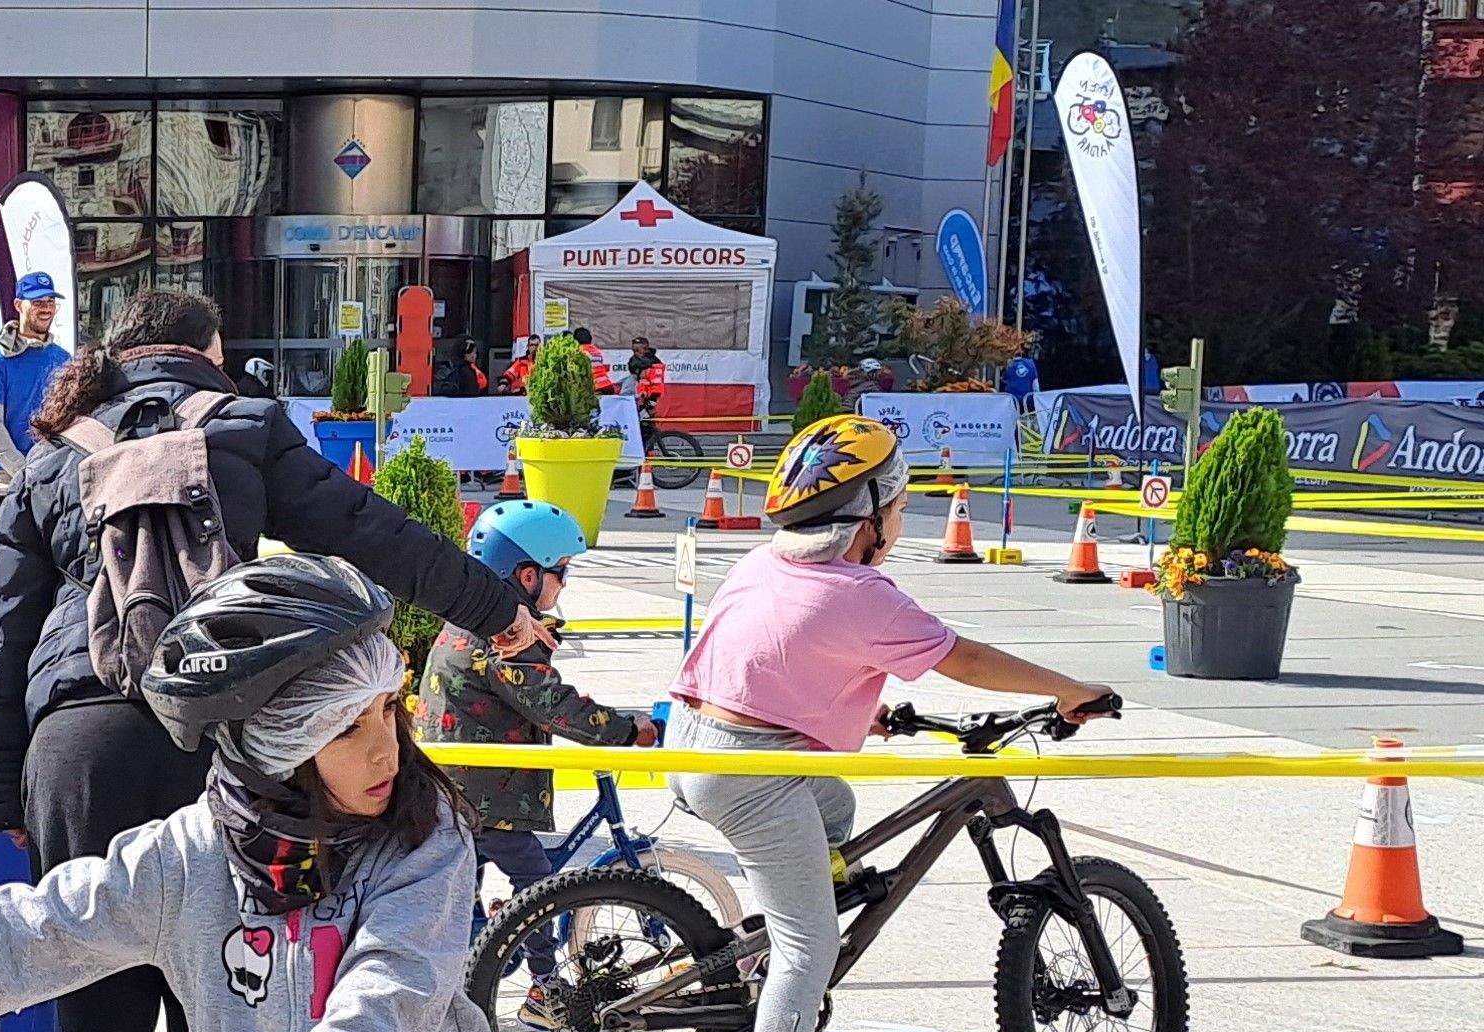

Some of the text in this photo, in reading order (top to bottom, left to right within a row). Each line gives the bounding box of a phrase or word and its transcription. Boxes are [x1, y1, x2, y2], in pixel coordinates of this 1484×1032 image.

[562, 247, 747, 267] PUNT DE SOCORS
[612, 364, 630, 373] CRE
[1081, 412, 1178, 453] Andorra
[1283, 429, 1340, 464] orra
[1386, 425, 1484, 476] Ando
[178, 655, 227, 674] GIRO
